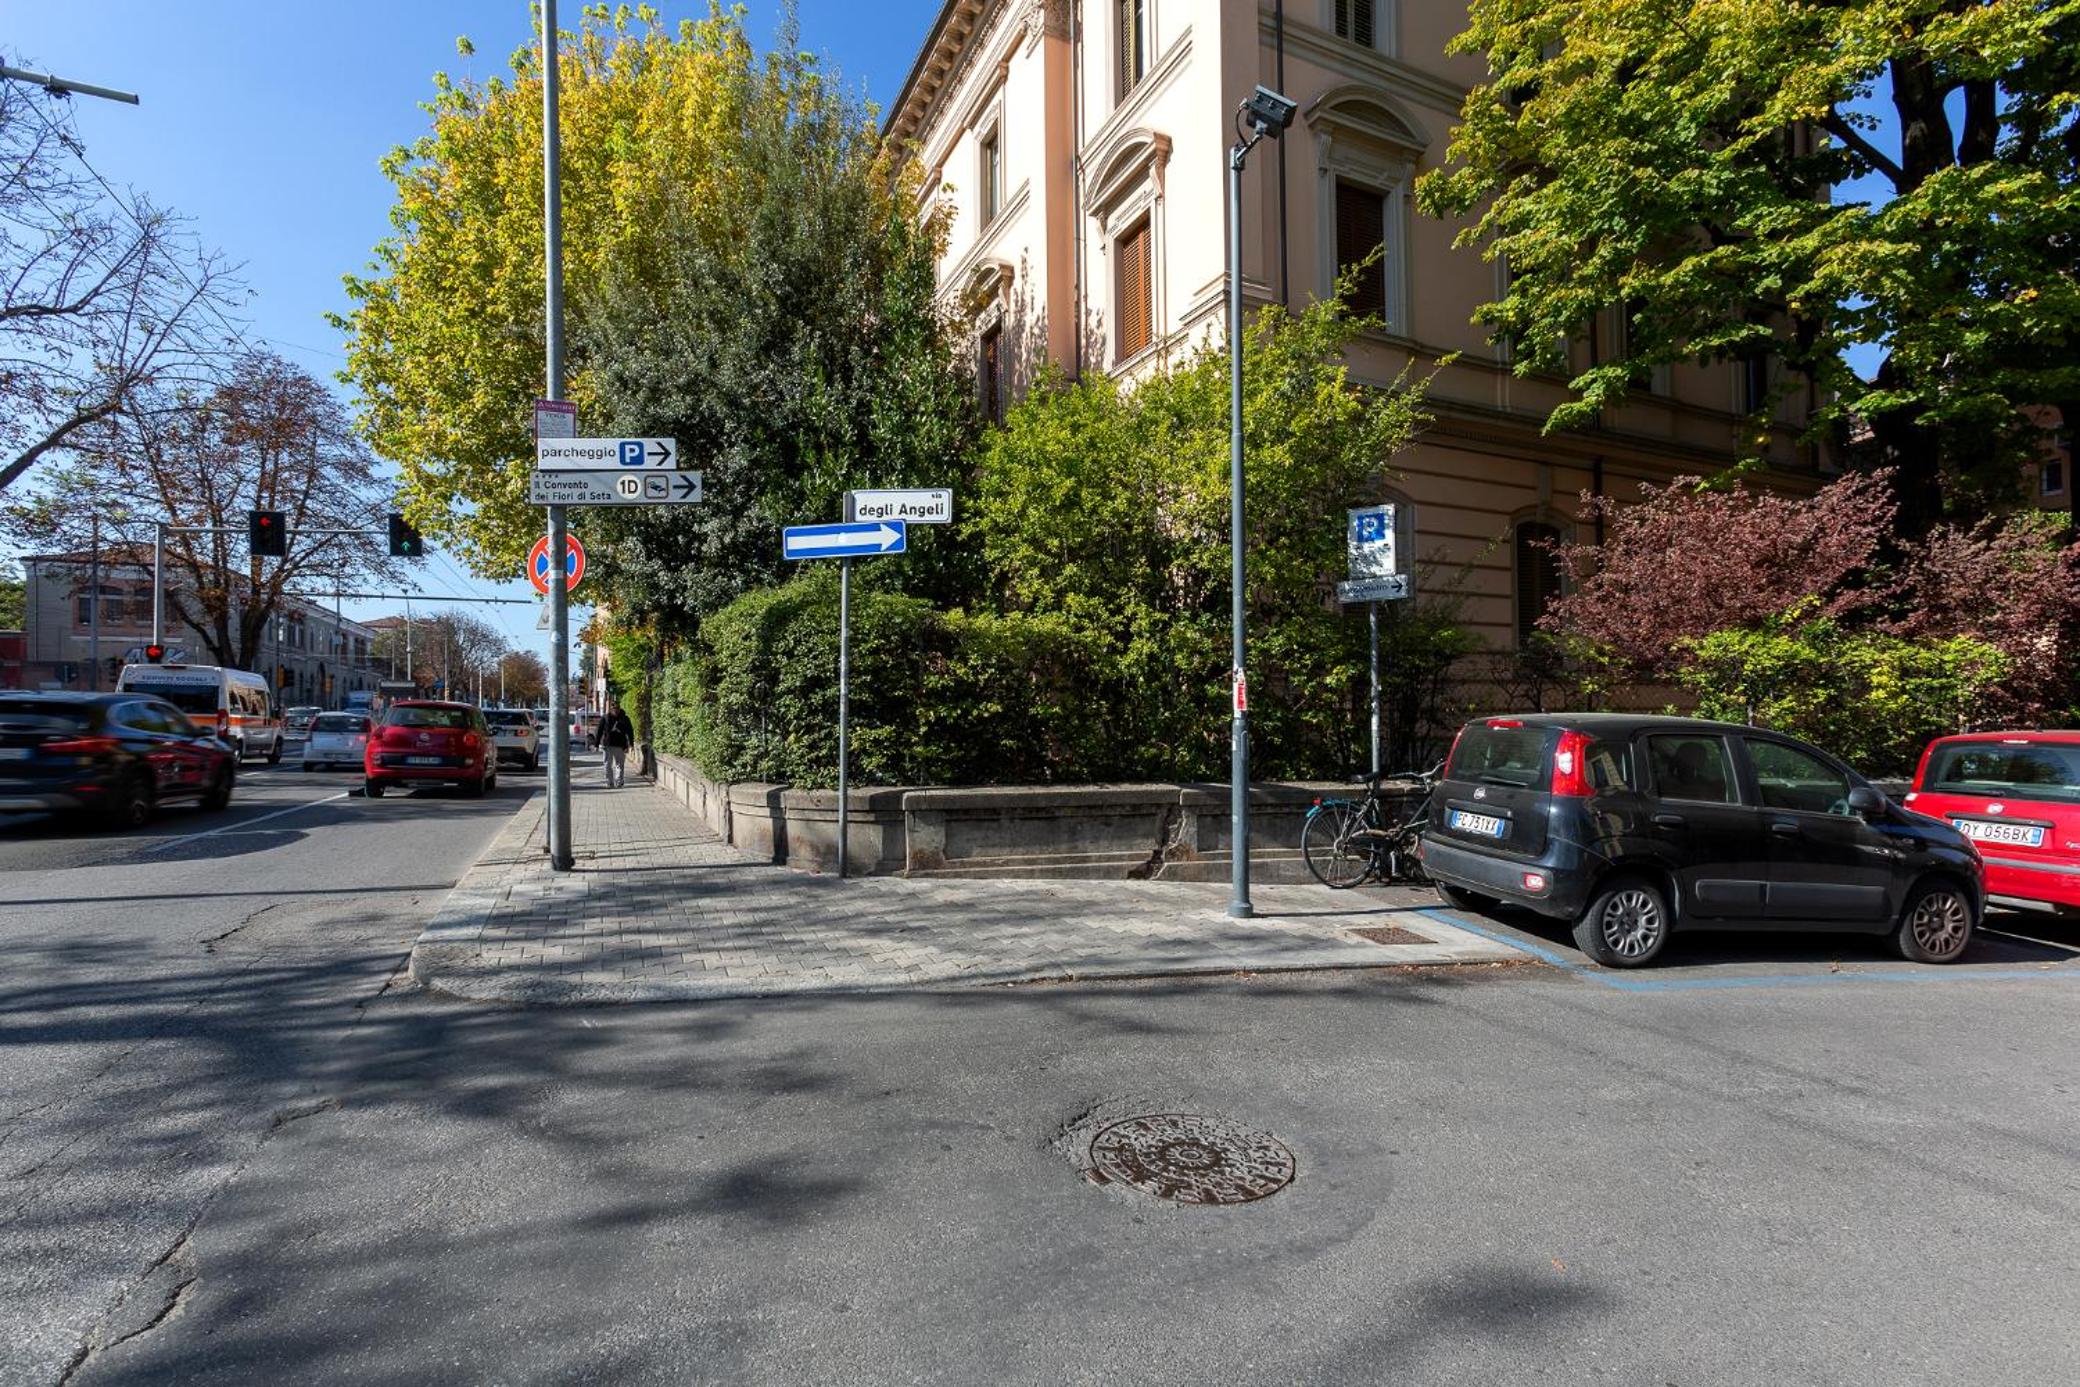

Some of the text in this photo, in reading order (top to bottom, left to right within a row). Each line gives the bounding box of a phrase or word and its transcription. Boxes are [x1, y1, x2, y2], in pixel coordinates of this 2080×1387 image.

[541, 447, 616, 460] parcheggio
[544, 480, 589, 489] Convento
[619, 479, 638, 495] 1D
[534, 490, 612, 500] dei Fiori di Seta
[859, 502, 944, 518] degli Angeli
